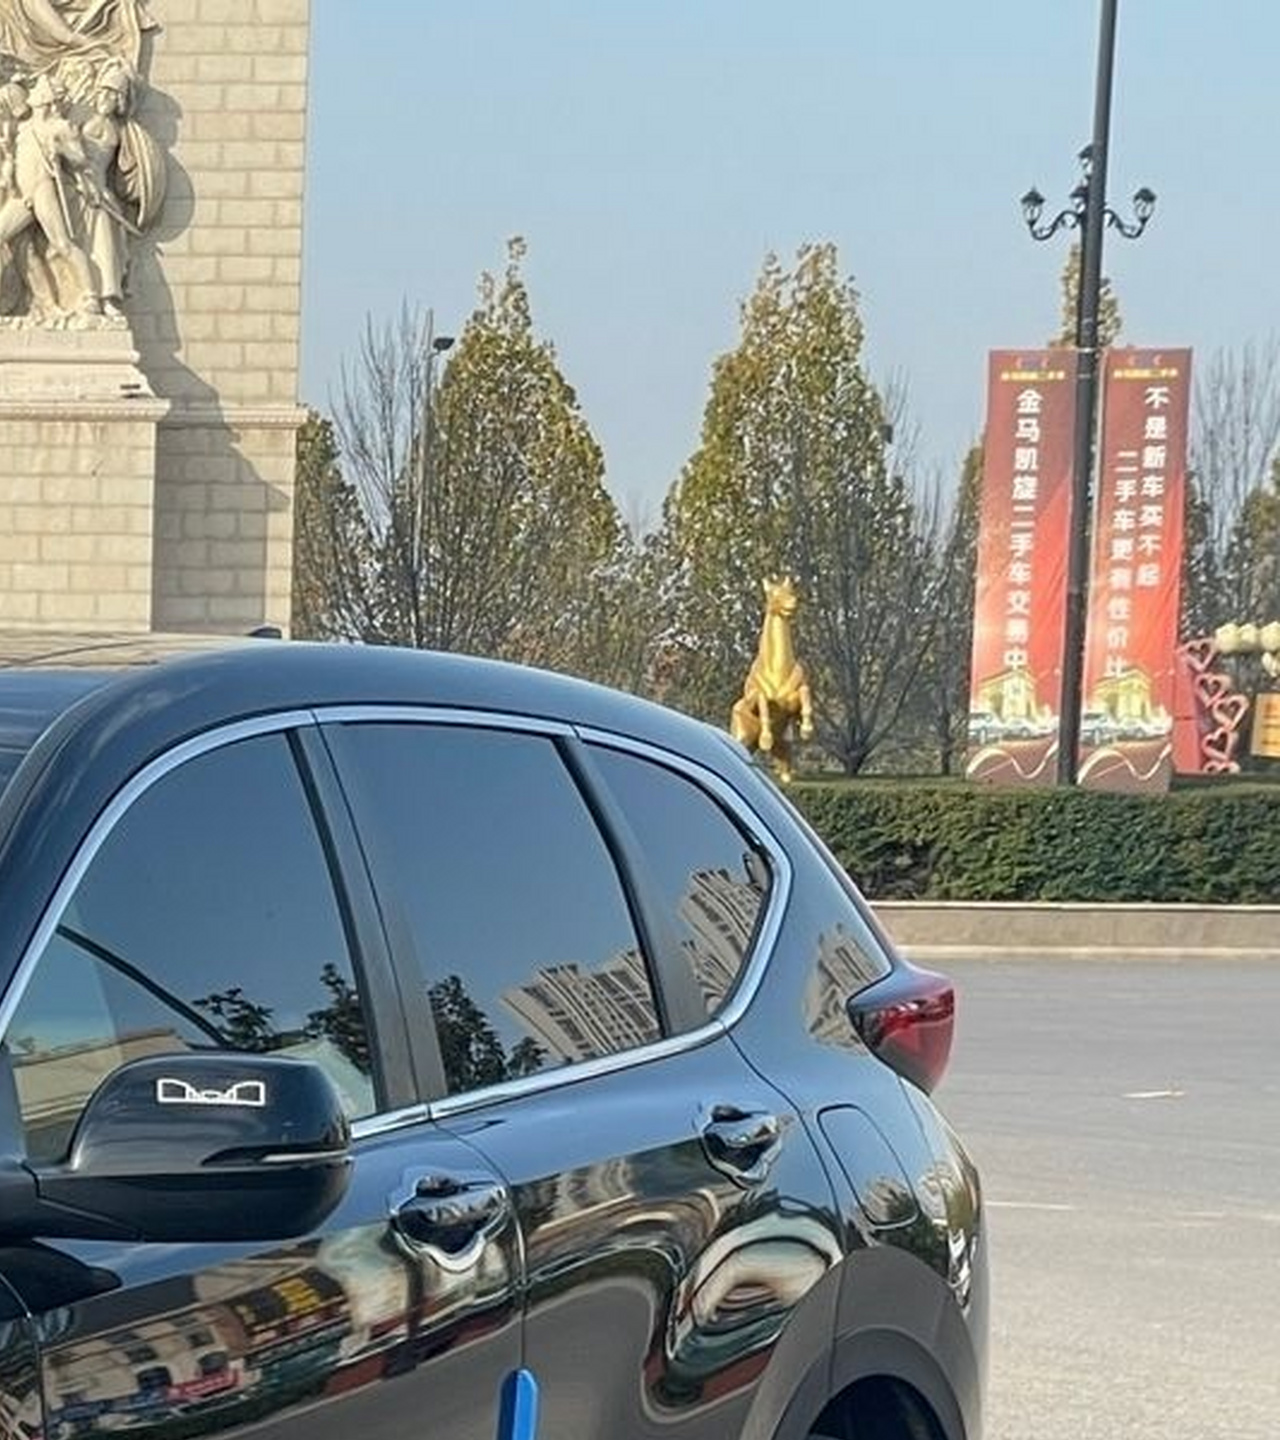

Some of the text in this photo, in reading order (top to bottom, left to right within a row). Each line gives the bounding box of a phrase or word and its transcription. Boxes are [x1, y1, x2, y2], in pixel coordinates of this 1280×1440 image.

[1136, 387, 1170, 587] 不是新车买不起
